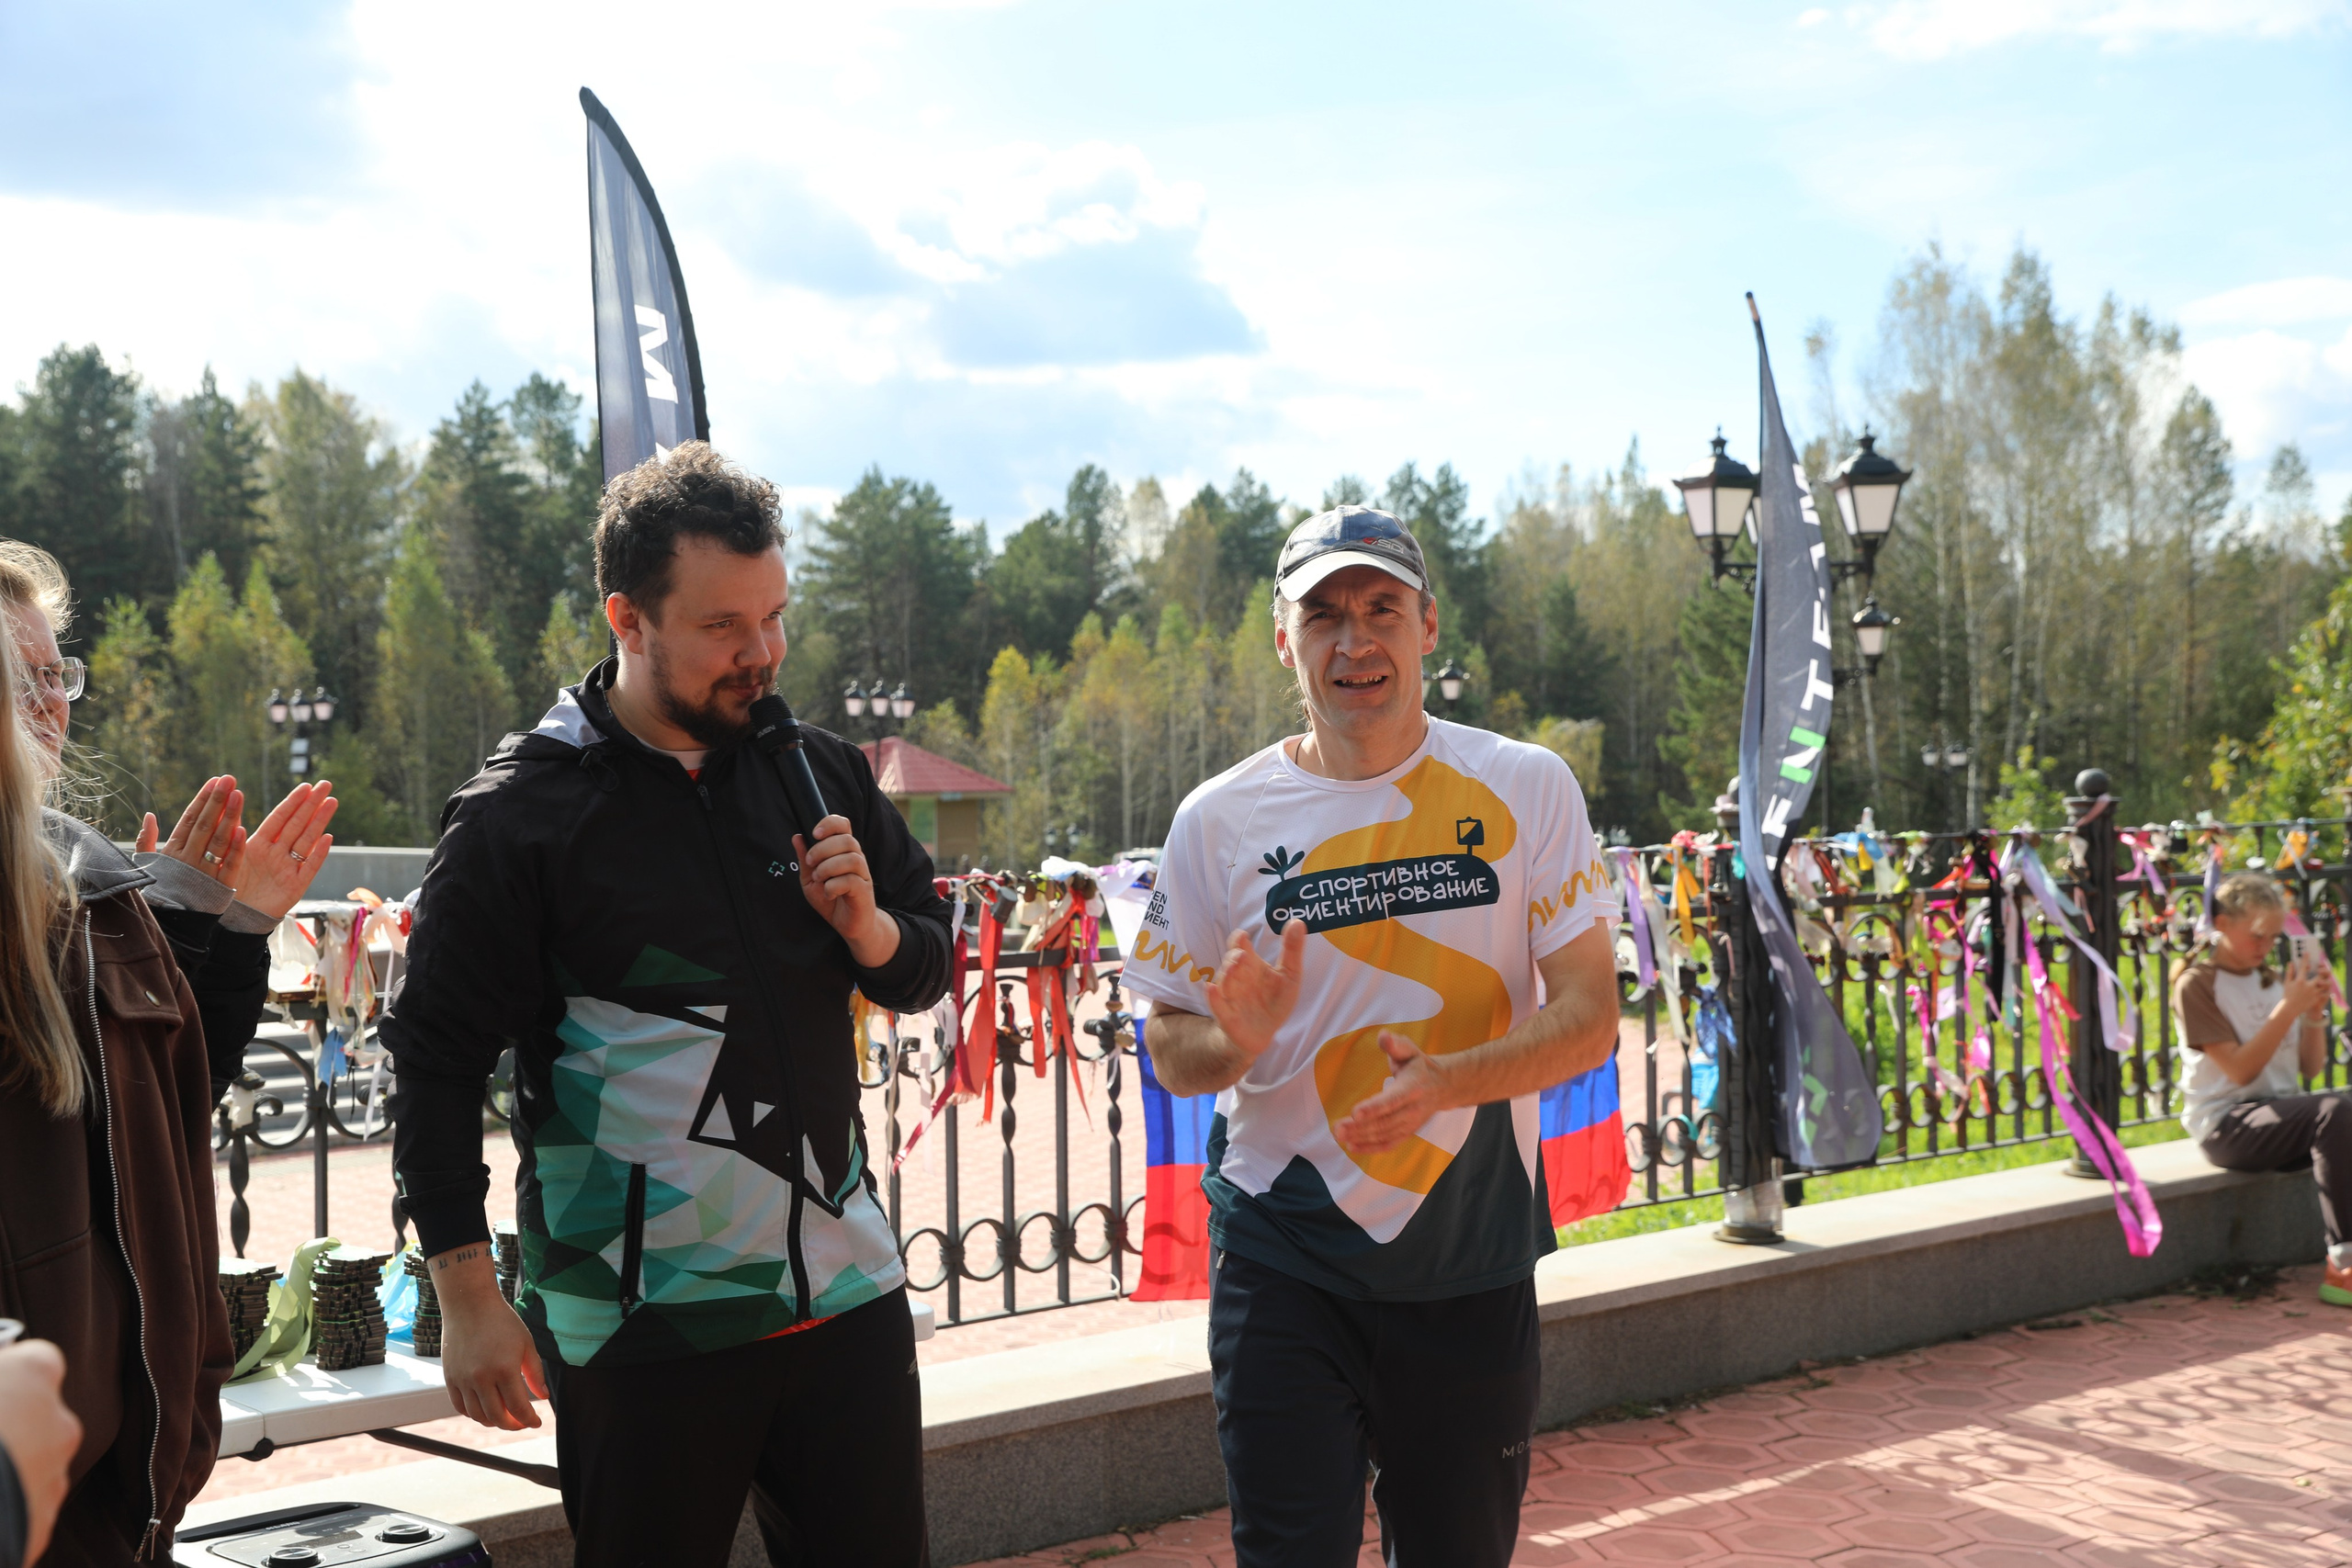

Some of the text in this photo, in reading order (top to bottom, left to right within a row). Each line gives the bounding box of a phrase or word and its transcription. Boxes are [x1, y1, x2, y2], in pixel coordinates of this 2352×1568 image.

[789, 862, 799, 872] O
[1299, 860, 1460, 898] СПОРТИВНОЕ
[1151, 890, 1168, 905] EN
[1148, 900, 1164, 915] ND
[1144, 910, 1170, 931] ИЕНТ
